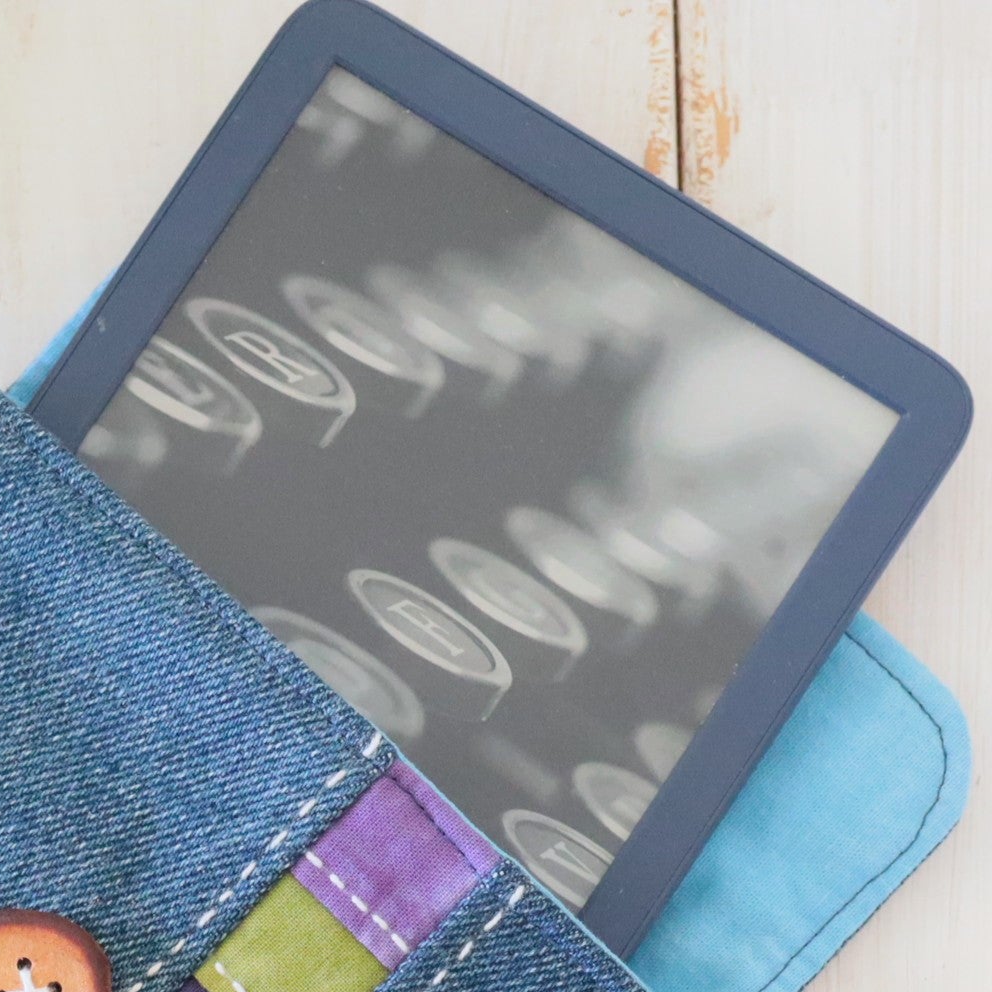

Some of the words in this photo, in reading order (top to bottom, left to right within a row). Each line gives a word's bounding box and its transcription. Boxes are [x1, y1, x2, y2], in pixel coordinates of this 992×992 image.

[224, 331, 320, 383] R
[387, 599, 465, 657] F
[539, 841, 601, 886] V
